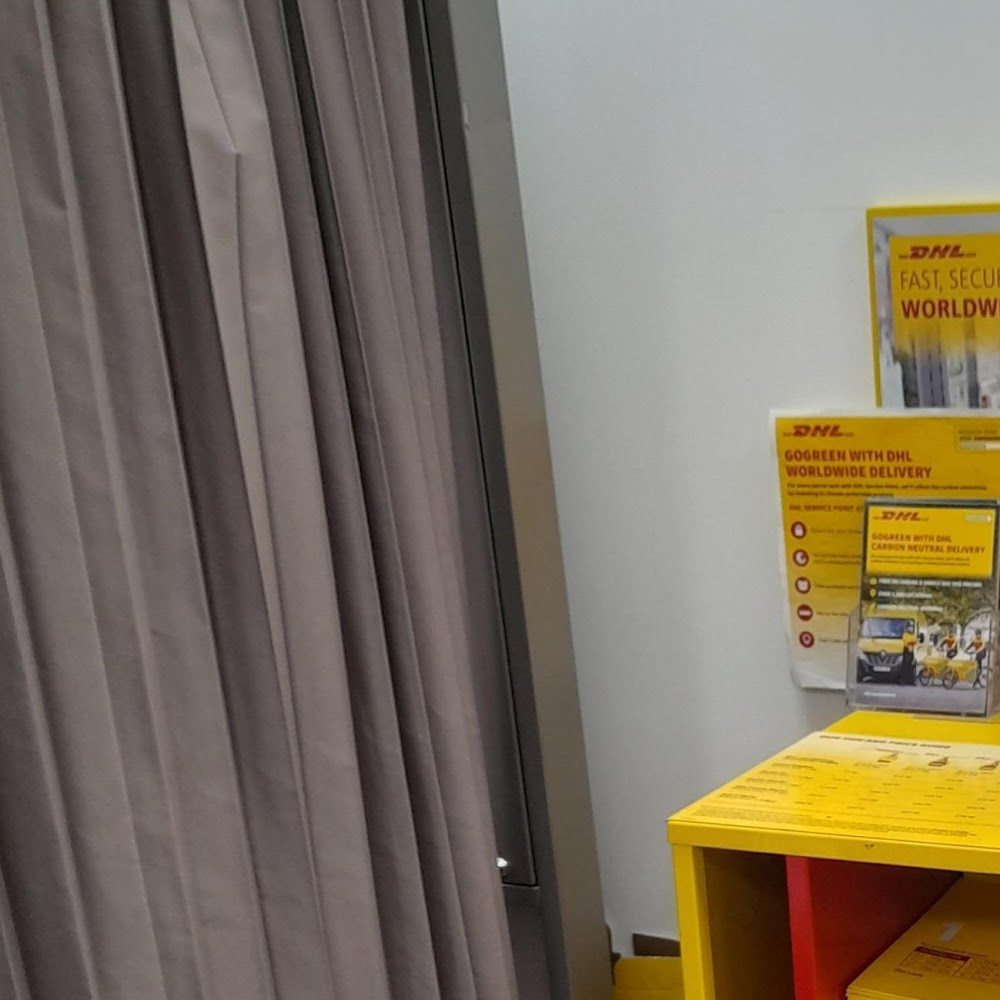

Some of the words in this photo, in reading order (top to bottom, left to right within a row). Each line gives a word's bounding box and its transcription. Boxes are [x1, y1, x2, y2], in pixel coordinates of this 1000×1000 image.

[910, 245, 966, 259] DHL
[900, 270, 943, 291] FAST,
[793, 425, 843, 437] DHL
[785, 450, 847, 462] GOGREEN
[849, 450, 883, 462] WITH
[887, 451, 912, 463] DHL
[786, 466, 866, 478] WORLDWIDE
[870, 467, 932, 479] DELIVERY
[881, 511, 921, 522] DHL
[908, 545, 944, 553] NEUTRAL
[946, 546, 985, 555] DELIVERY
